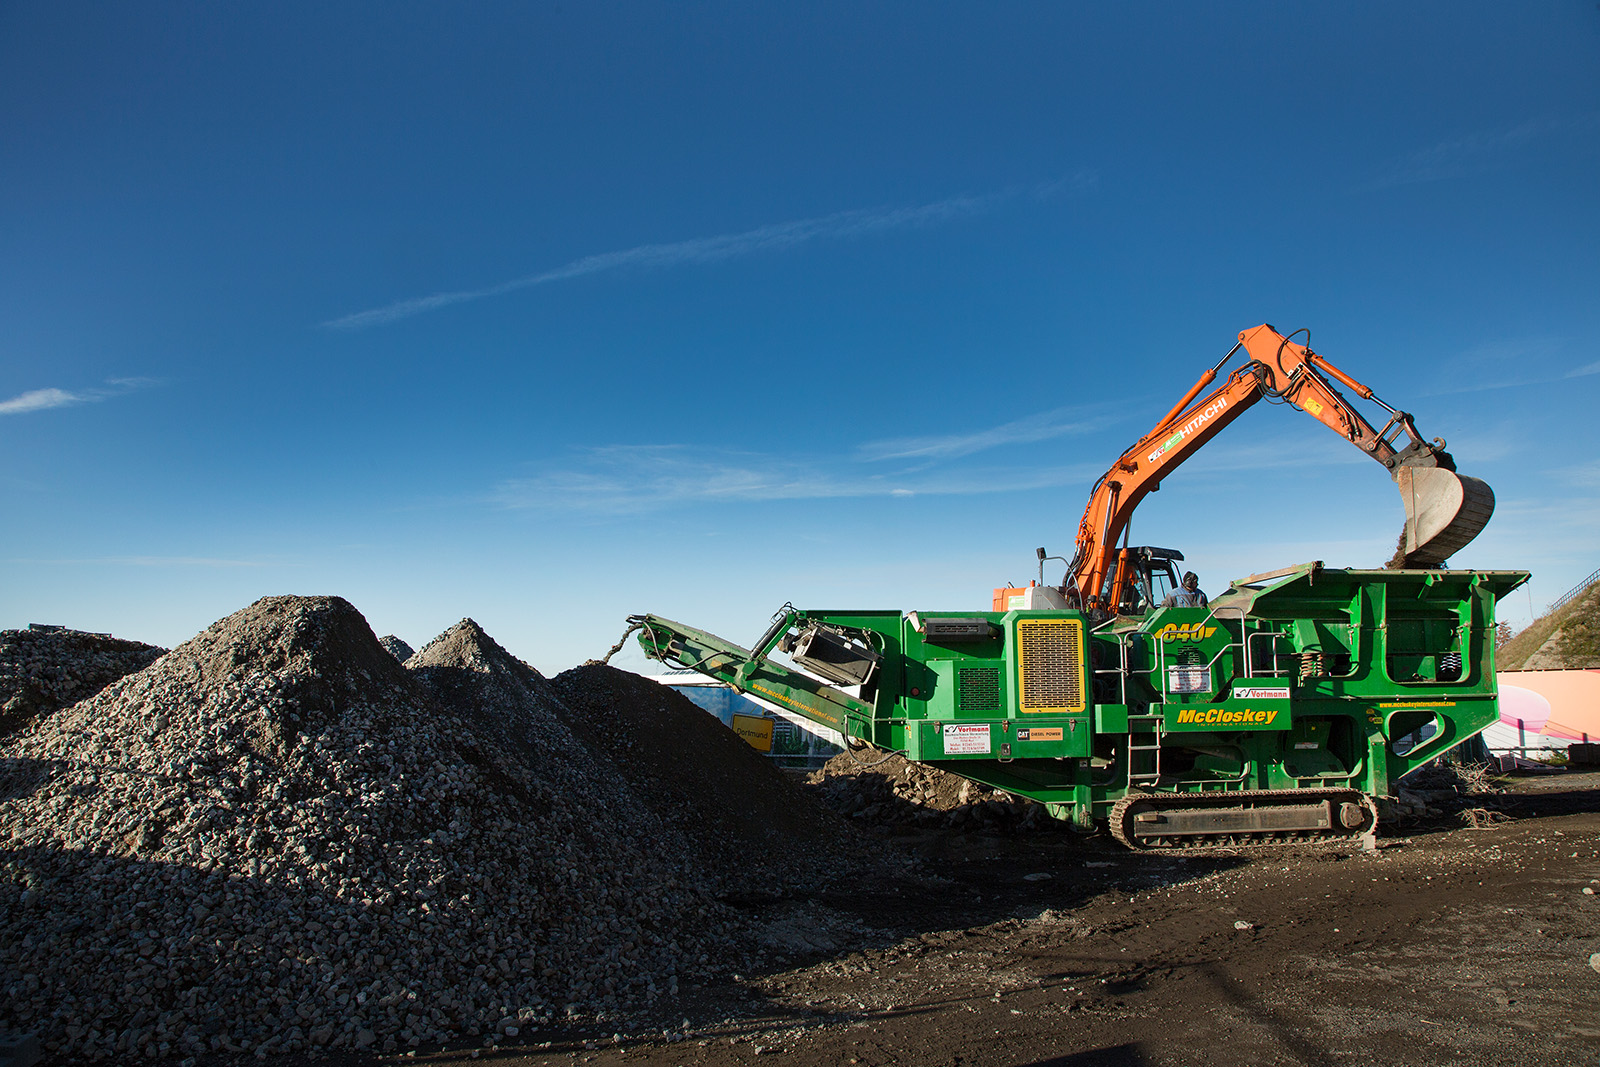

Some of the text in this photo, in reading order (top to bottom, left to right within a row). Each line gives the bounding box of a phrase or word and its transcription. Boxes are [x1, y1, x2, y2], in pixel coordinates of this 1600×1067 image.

[1179, 397, 1228, 439] HITACHI
[1250, 690, 1287, 698] Vortmann
[752, 683, 838, 724] www.mccloskeyinternational.com
[1176, 708, 1279, 725] McCloskey
[736, 727, 769, 739] Dortmund
